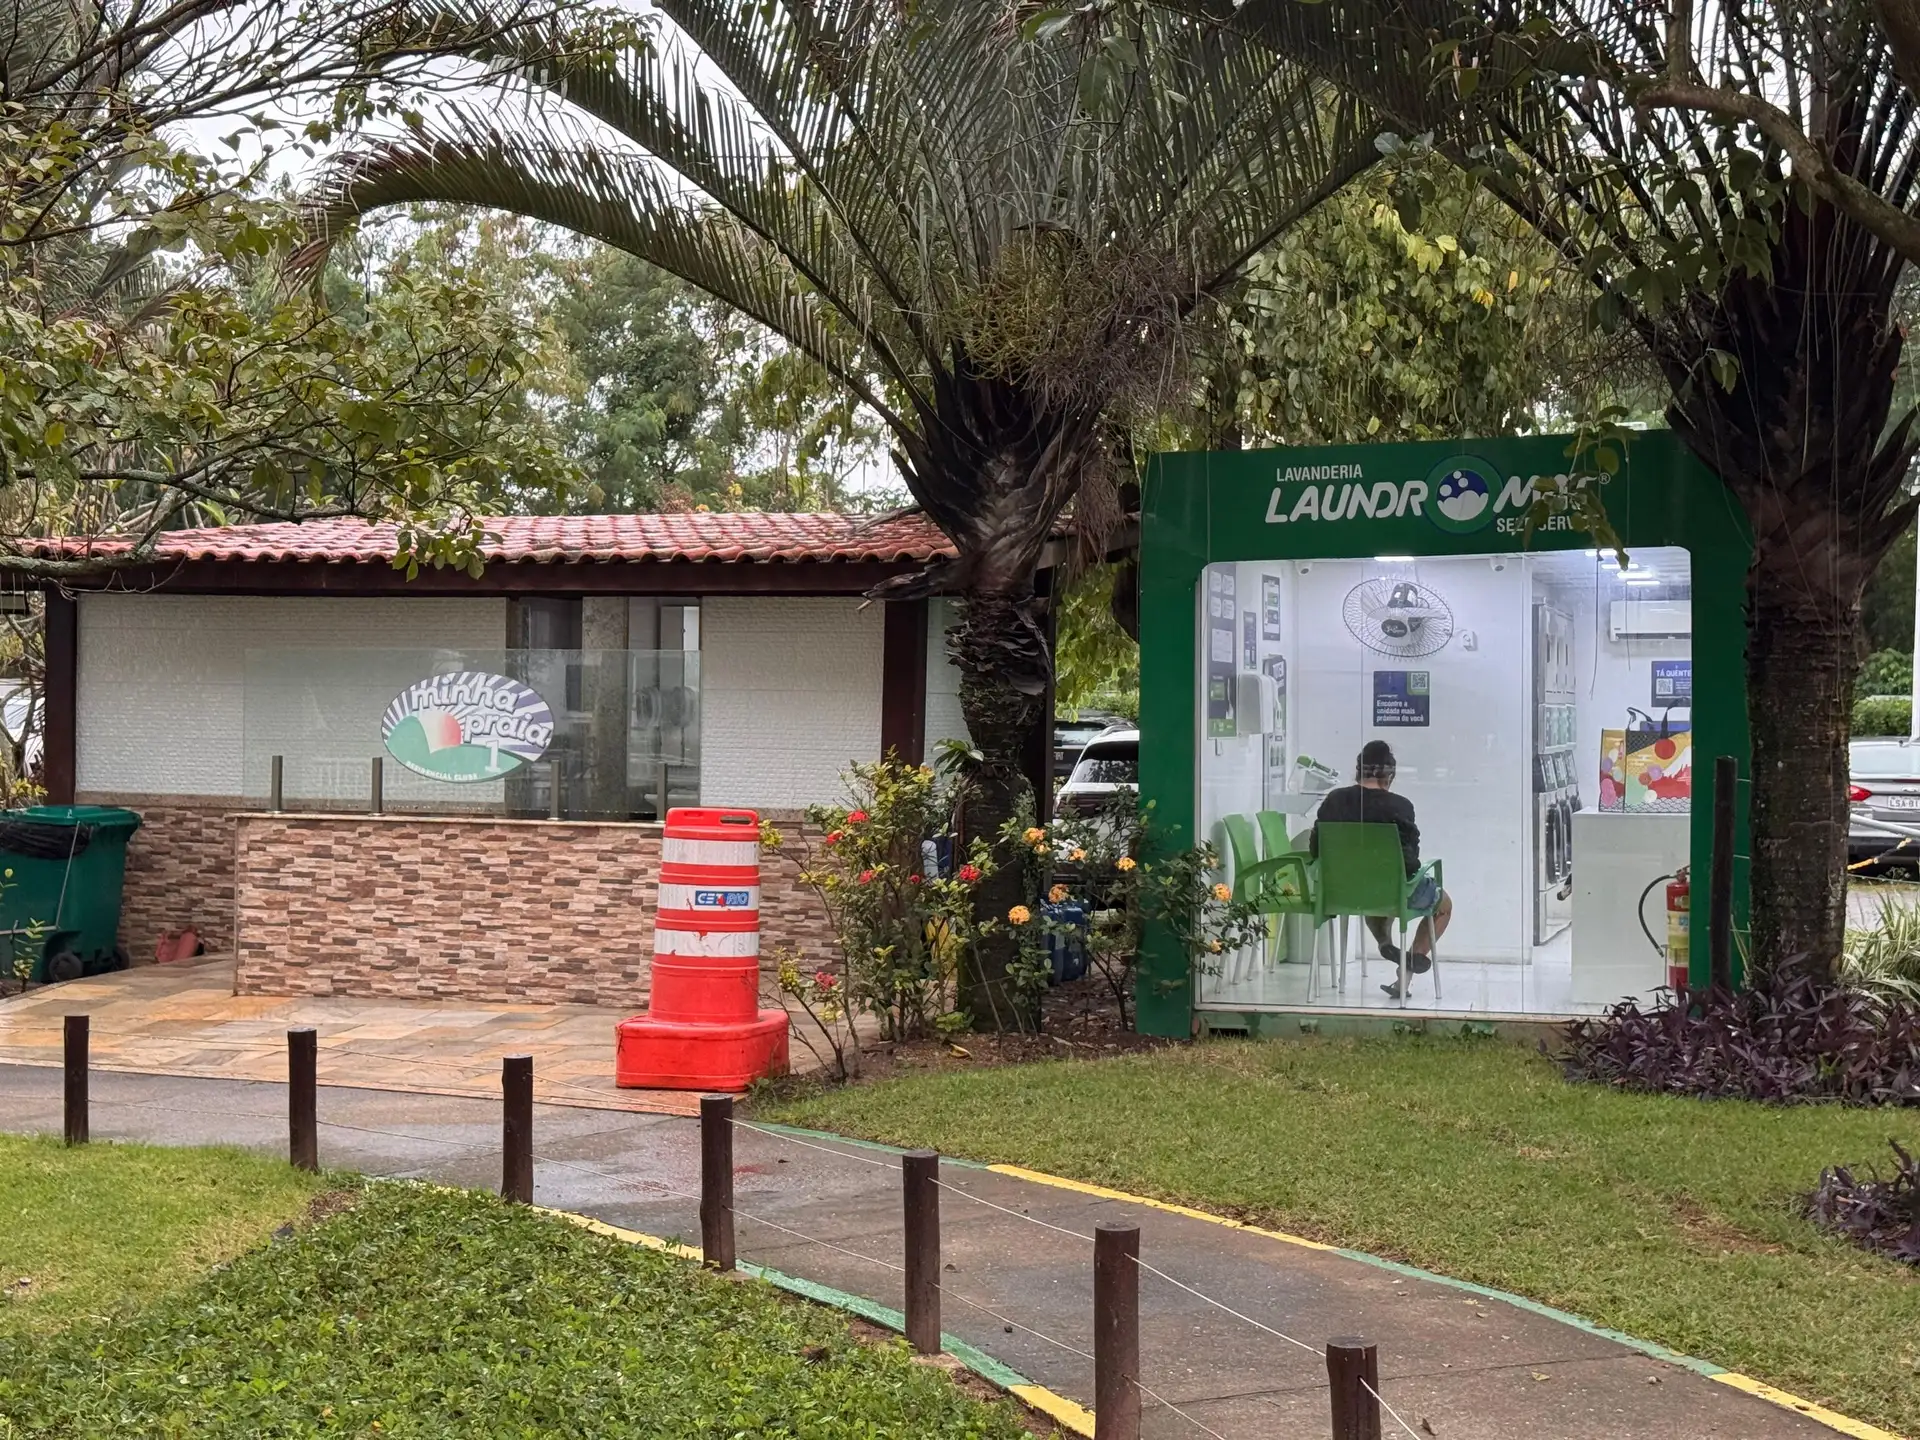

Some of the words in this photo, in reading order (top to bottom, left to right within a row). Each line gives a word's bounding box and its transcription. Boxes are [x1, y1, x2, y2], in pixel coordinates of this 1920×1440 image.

[1276, 463, 1363, 482] LAVANDERIA
[411, 672, 519, 713] minha
[463, 713, 551, 748] praia
[484, 739, 501, 773] 1
